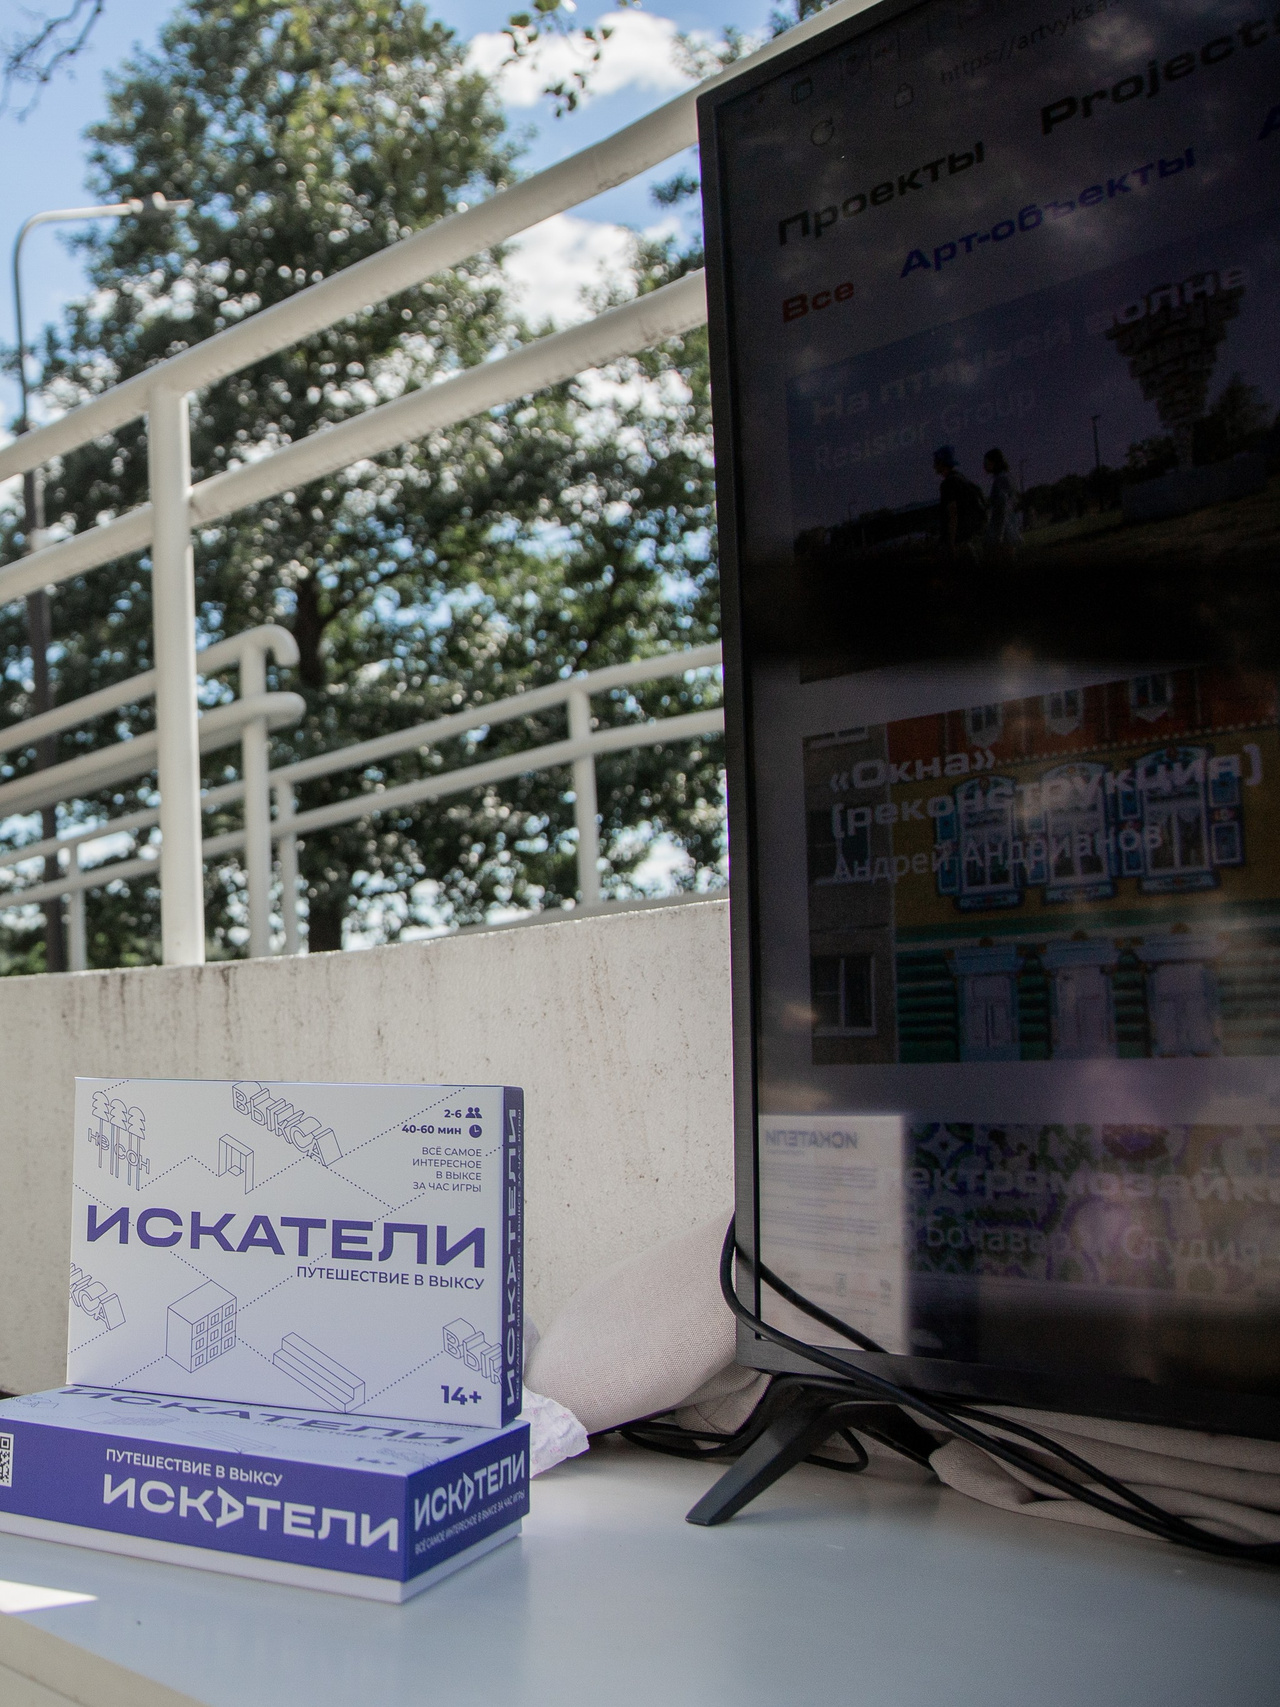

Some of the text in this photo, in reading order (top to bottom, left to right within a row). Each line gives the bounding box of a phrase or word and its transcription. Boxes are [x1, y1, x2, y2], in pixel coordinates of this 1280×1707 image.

[778, 142, 986, 246] Проекты
[782, 281, 855, 324] Все
[900, 148, 1197, 279] Арт-объекты
[830, 749, 997, 795] «Окна»
[832, 840, 951, 884] Андрей
[402, 1124, 462, 1135] 40-60 мин
[444, 1109, 462, 1118] 2-6
[412, 1158, 482, 1169] ИНТЕРЕСНОЕ
[422, 1145, 482, 1157] ВСЁ САМОЕ
[413, 1181, 482, 1193] ЗА ЧАС ИГРЫ
[436, 1171, 482, 1181] В ВЫКСЕ
[86, 1204, 486, 1269] ИСКАТЕЛИ
[297, 1266, 485, 1290] ПУТЕШЕСТВИЕ В ВЫКСУ
[507, 1109, 517, 1406] ИСКАТЕЛИ
[441, 1385, 482, 1406] 14+
[58, 1388, 465, 1445] ИСКАТЕЛИ
[106, 1448, 283, 1487] ПУТЕШЕСТВИЕ В ВЫКСУ
[414, 1450, 525, 1532] ИСКАТЕЛИ
[103, 1473, 399, 1552] ИСКАТЕЛИ
